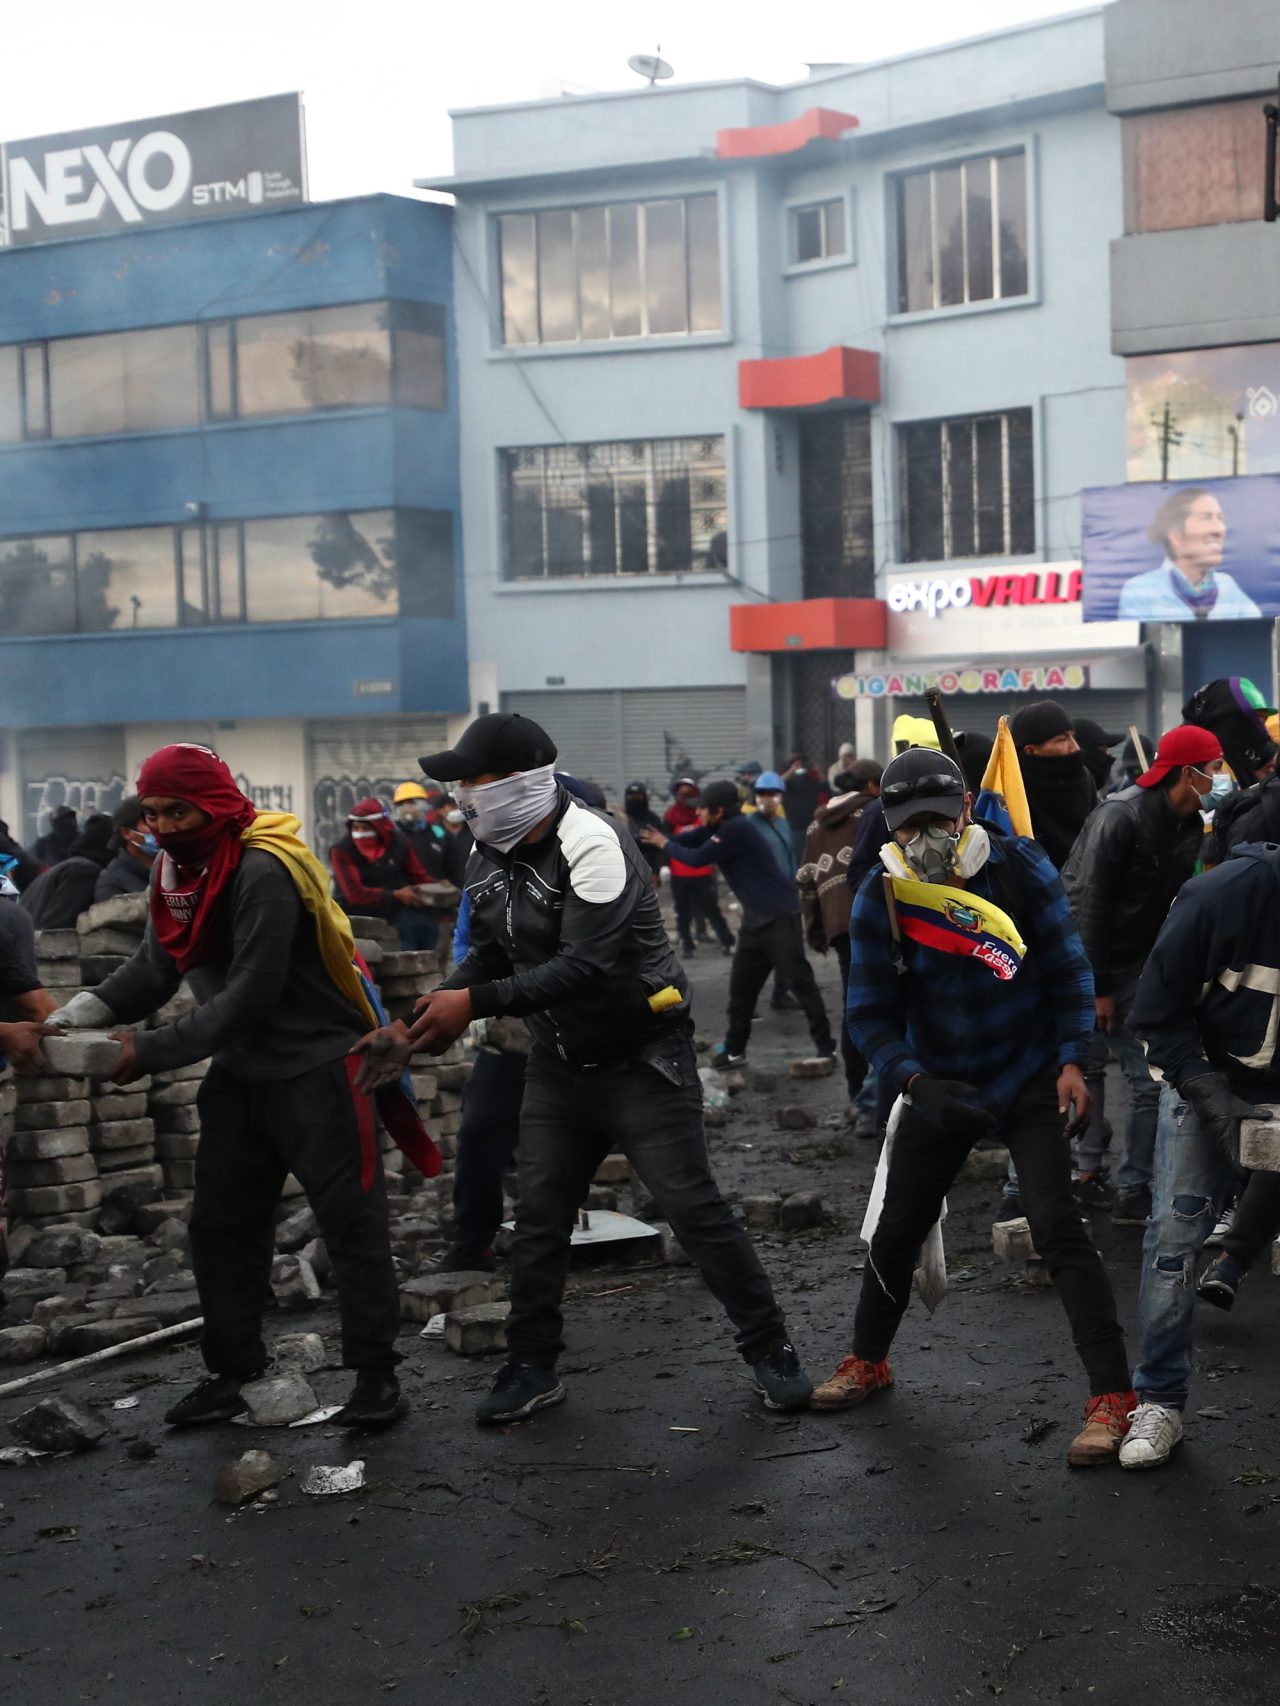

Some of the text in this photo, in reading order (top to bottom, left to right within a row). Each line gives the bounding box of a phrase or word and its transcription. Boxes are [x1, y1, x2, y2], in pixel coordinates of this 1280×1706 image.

[9, 131, 191, 230] NEXO
[192, 178, 246, 205] STM
[983, 940, 1018, 975] Fuera
